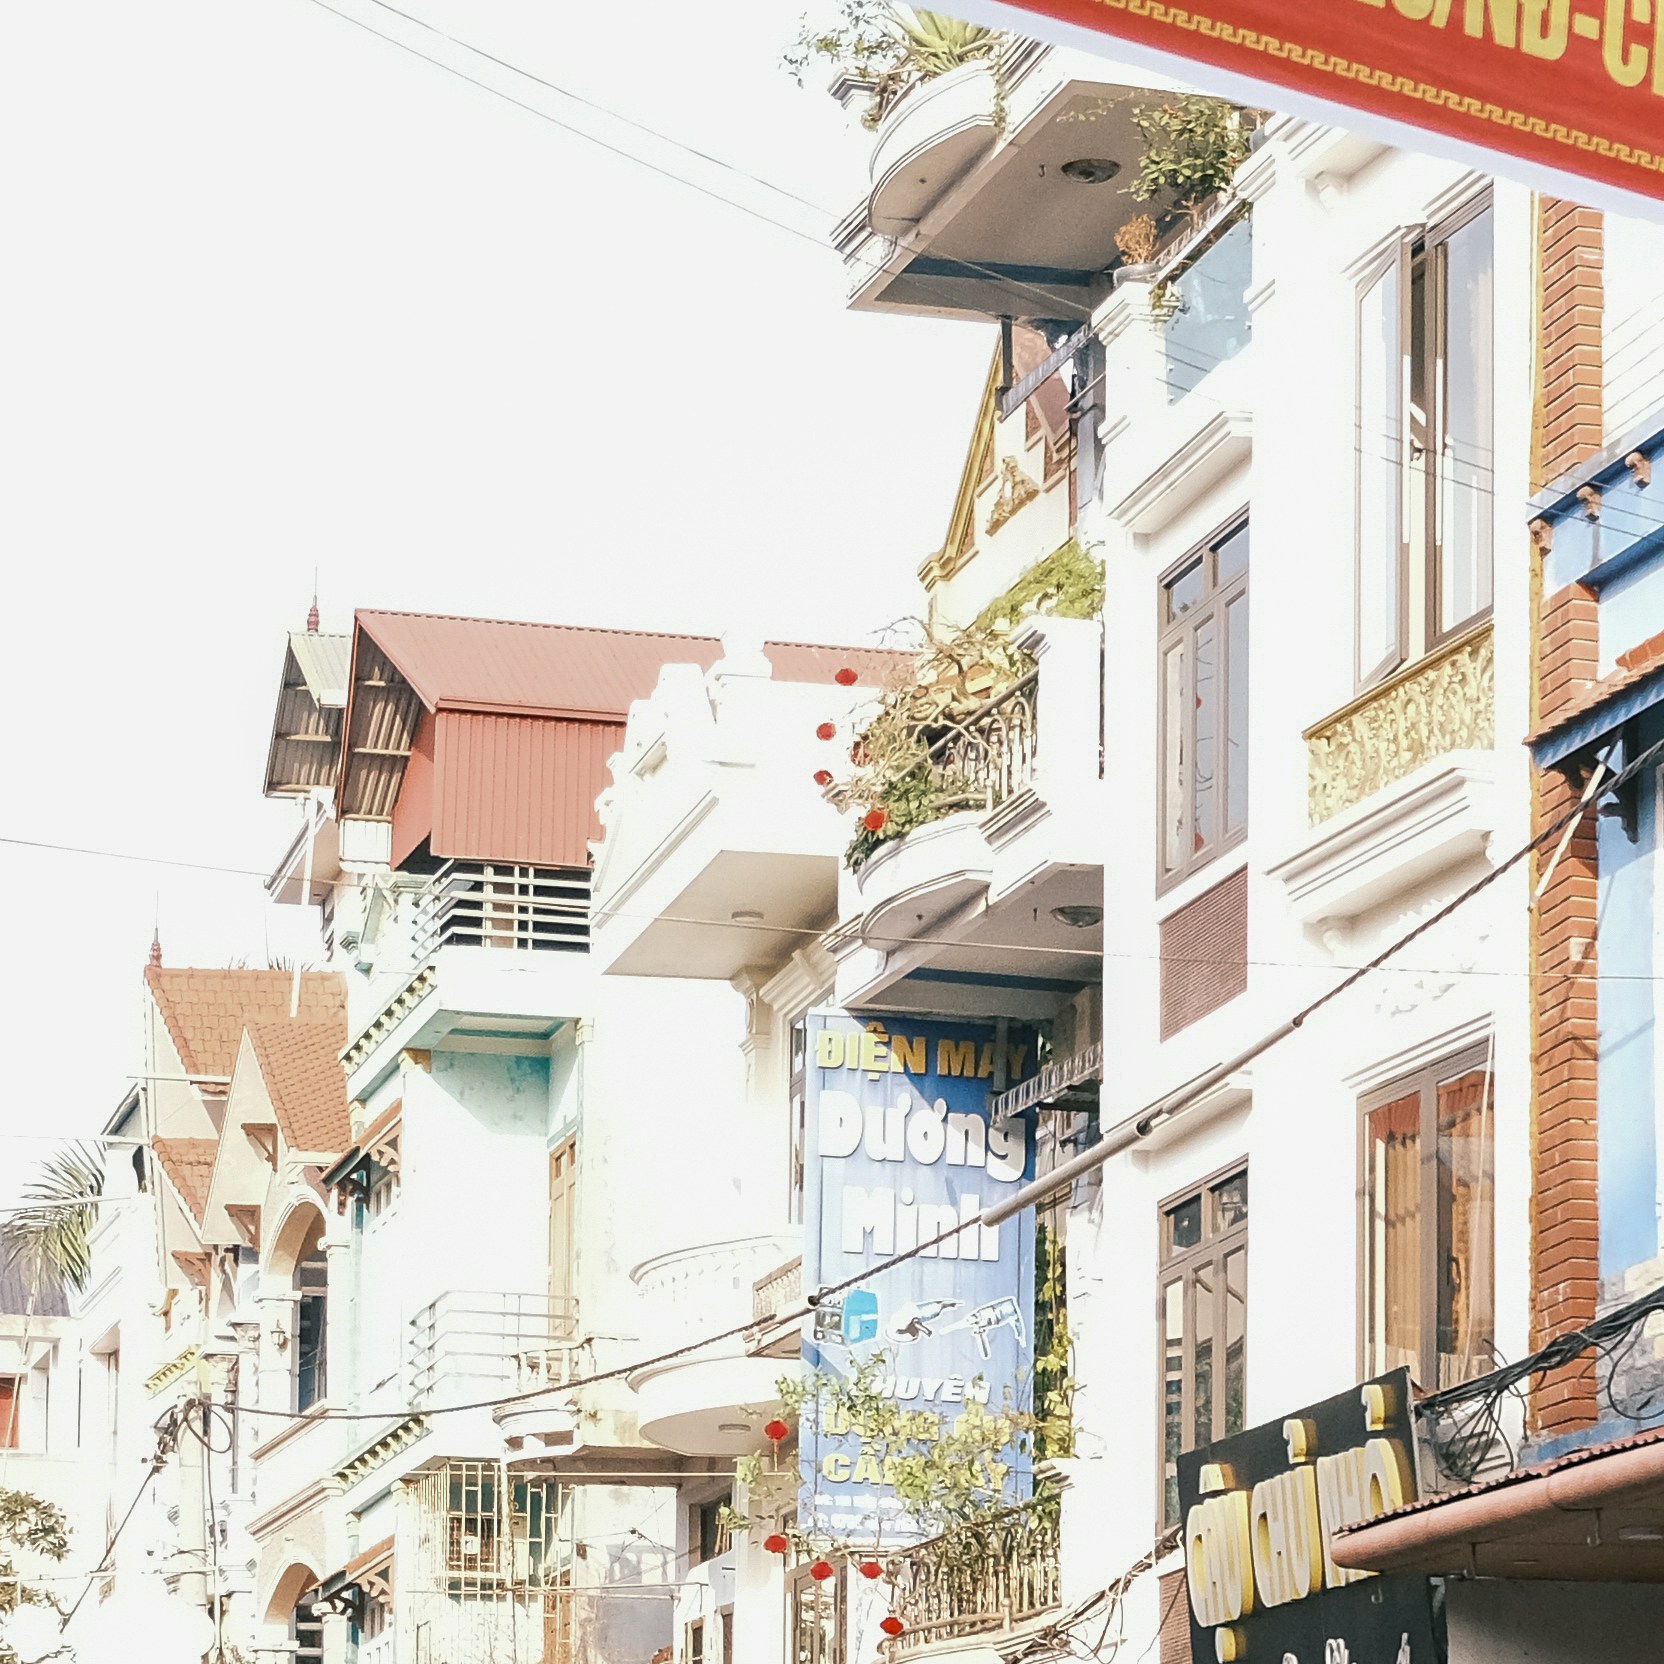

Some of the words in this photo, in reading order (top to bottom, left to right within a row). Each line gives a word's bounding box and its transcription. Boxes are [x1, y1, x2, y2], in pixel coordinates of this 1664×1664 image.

[815, 1021, 928, 1081] ĐIỆN
[818, 1090, 1026, 1183] Dương
[841, 1186, 1000, 1262] Minh
